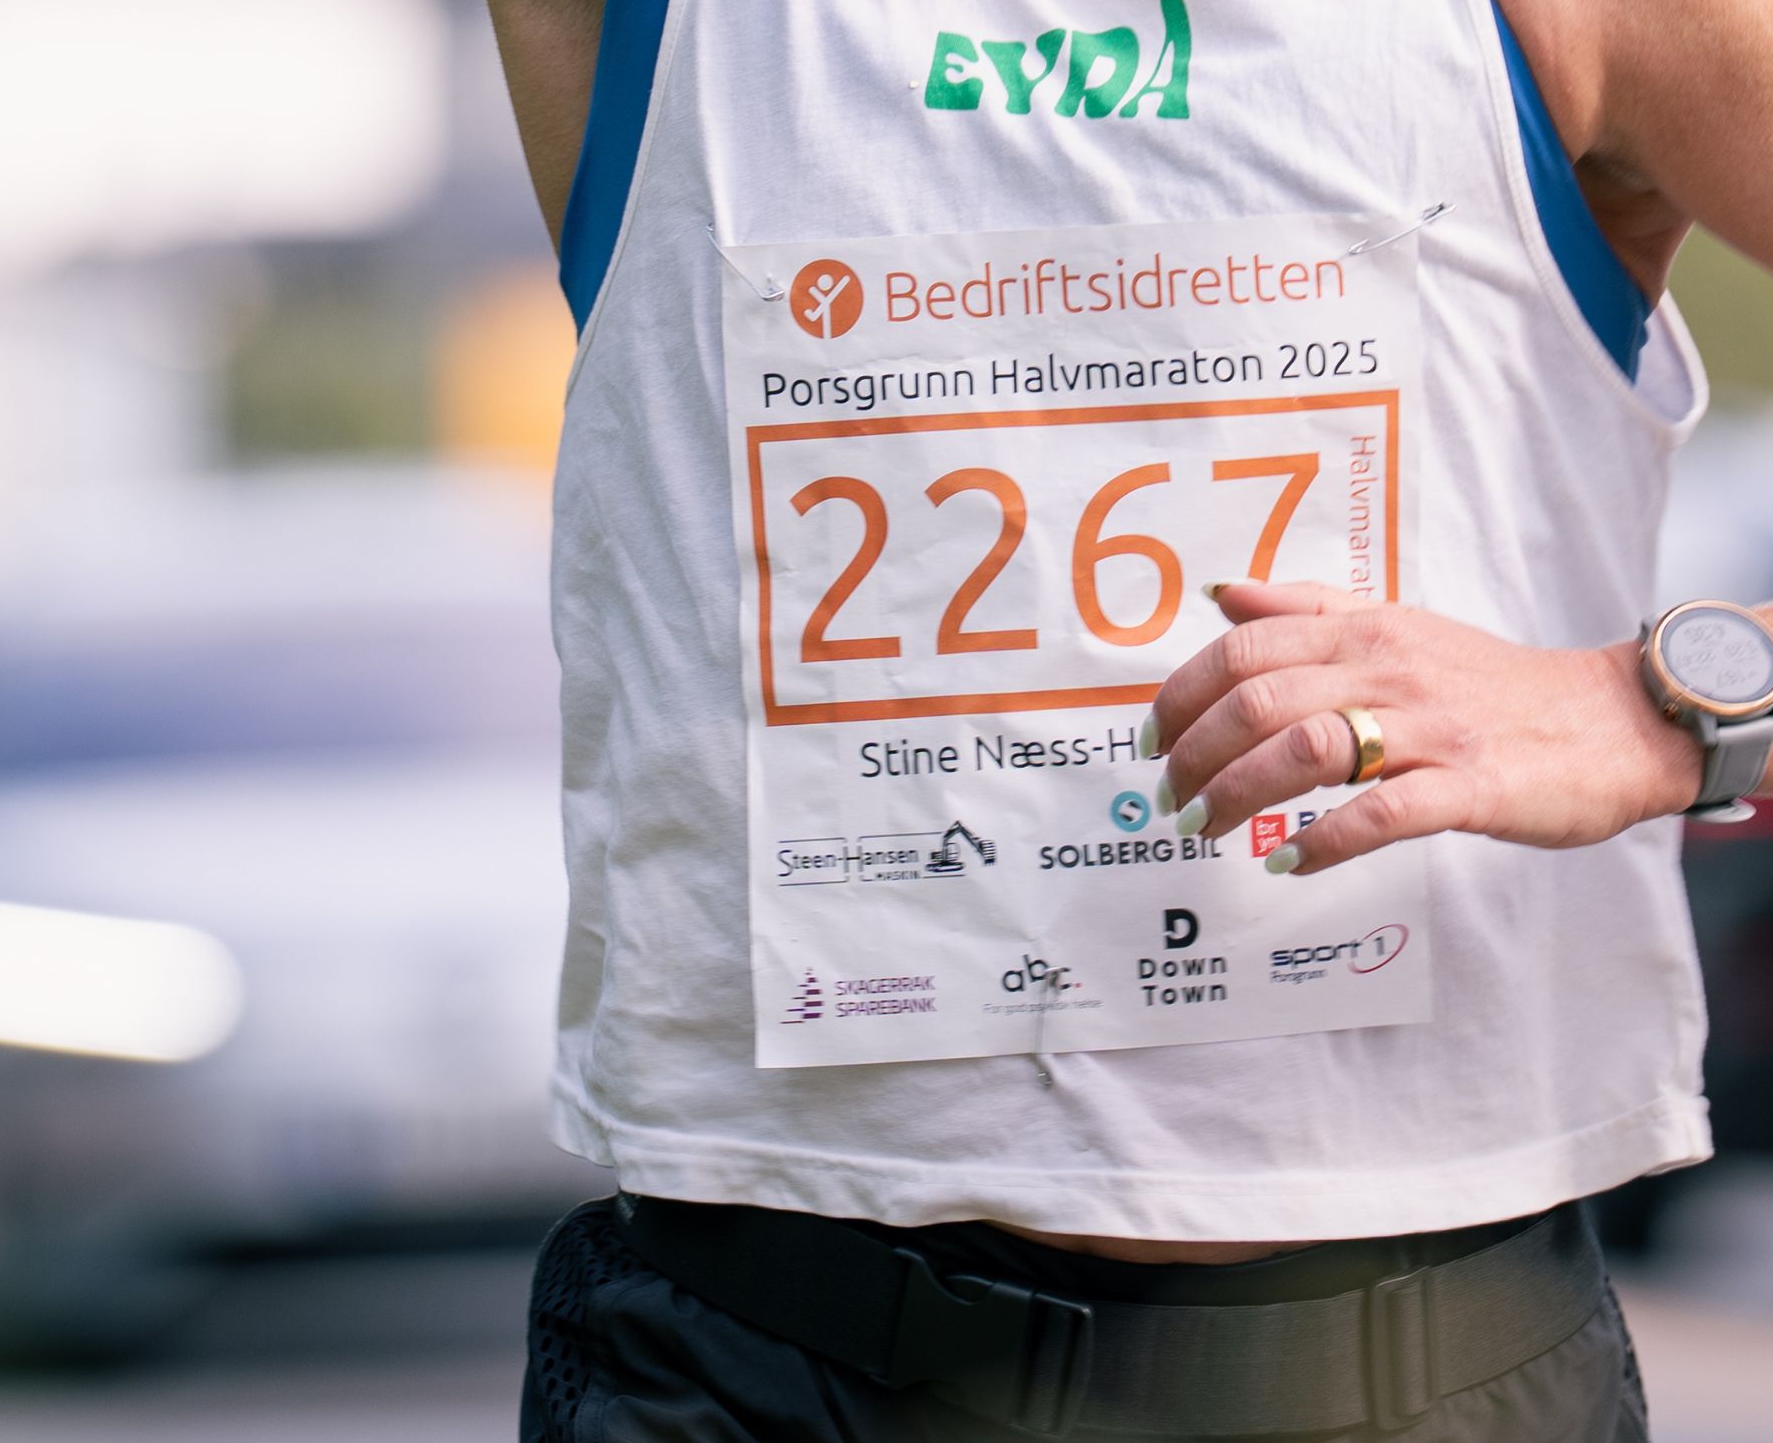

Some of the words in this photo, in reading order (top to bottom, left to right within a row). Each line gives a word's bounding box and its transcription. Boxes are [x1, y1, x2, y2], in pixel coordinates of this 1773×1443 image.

[883, 253, 1346, 324] Bedriftsidretten
[762, 370, 975, 411] Porsgrunn
[990, 353, 1264, 398] Halvmaraton
[1279, 338, 1380, 380] 2025
[1348, 435, 1378, 596] Halvmarat
[790, 452, 1320, 663] 2267
[860, 739, 959, 778] Stine
[975, 727, 1164, 770] Næss-H
[778, 845, 920, 877] Steen-Hansen
[1040, 838, 1175, 870] SOLBERG
[1181, 835, 1224, 861] BIL
[1138, 956, 1228, 980] Down
[1270, 939, 1363, 968] sport
[1373, 936, 1386, 956] 1
[834, 975, 936, 996] SKAGERRAK
[1141, 983, 1228, 1006] Town
[834, 997, 938, 1018] SPAREBANK
